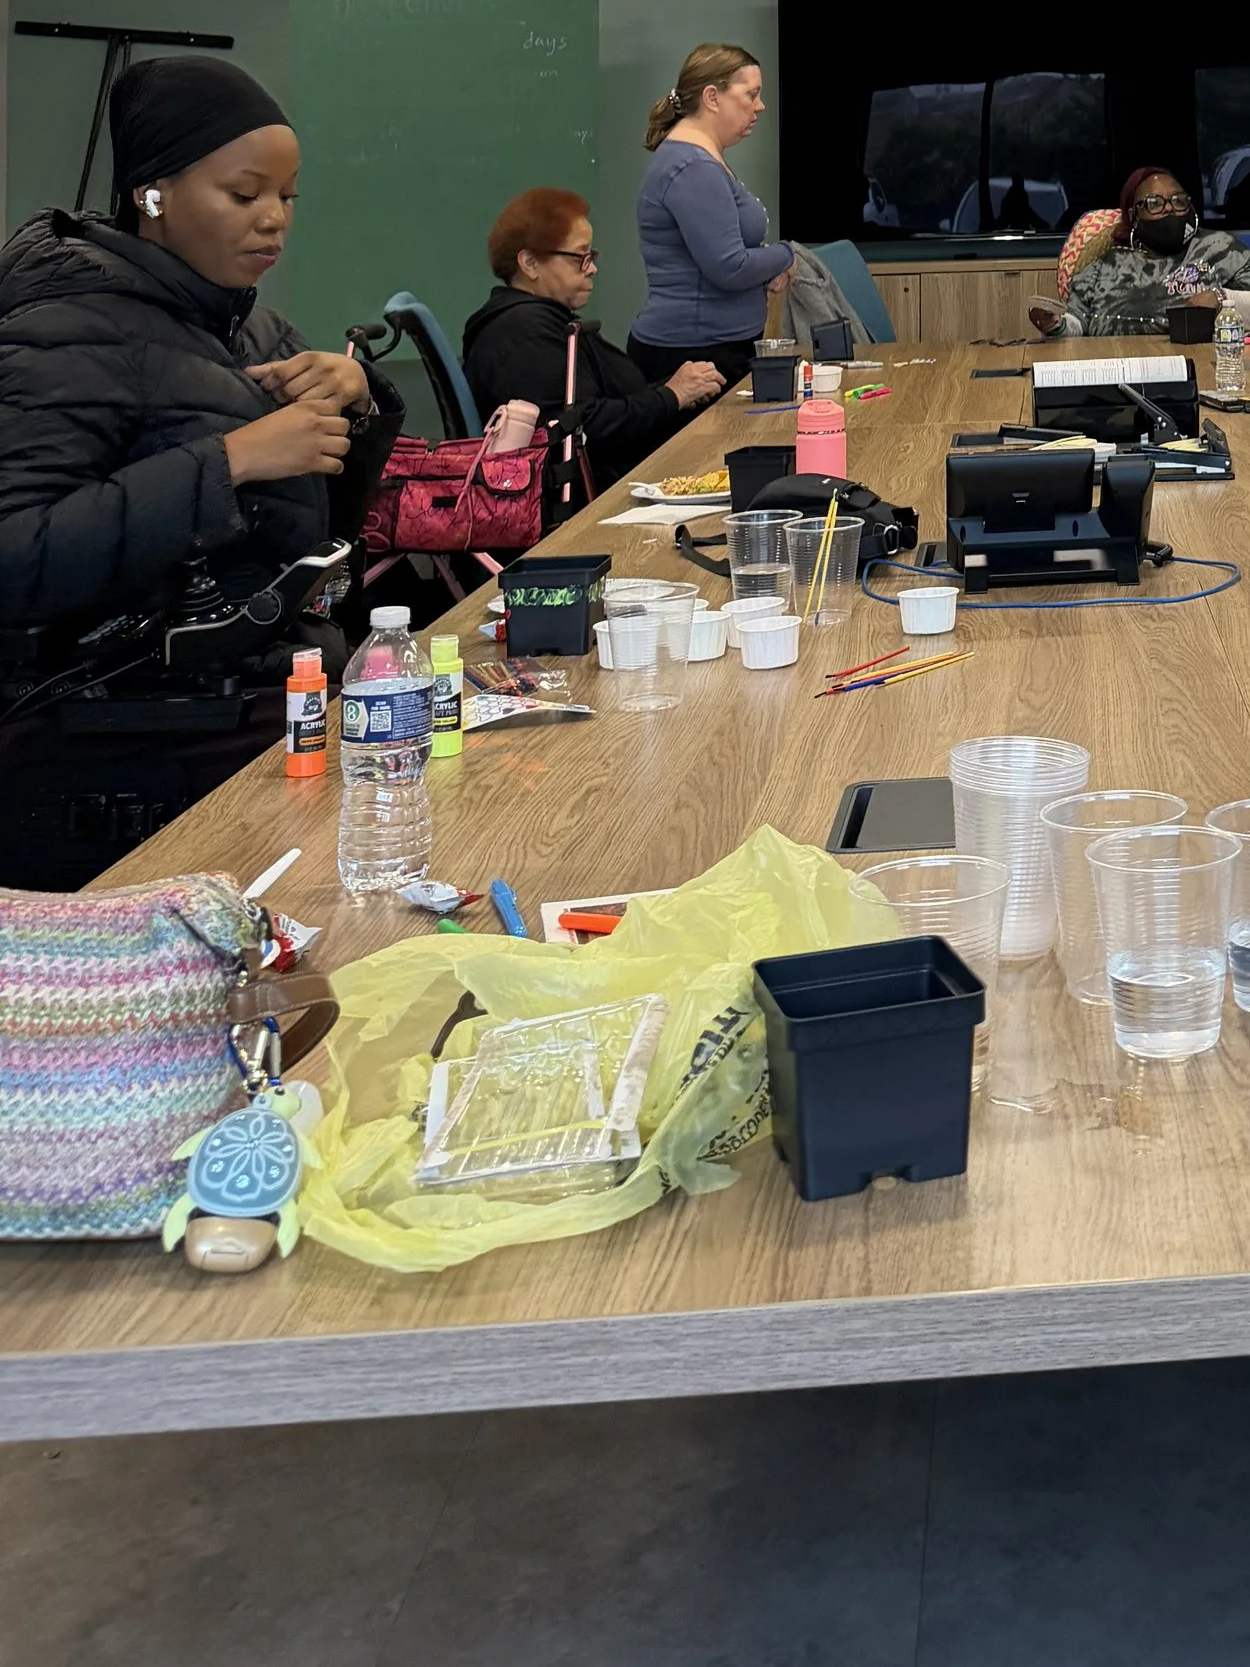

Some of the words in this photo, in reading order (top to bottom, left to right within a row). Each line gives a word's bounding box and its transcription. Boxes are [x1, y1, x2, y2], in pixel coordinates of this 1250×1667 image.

[522, 31, 569, 56] days
[435, 701, 458, 711] CRYLIC
[300, 719, 326, 730] ACRYLIC
